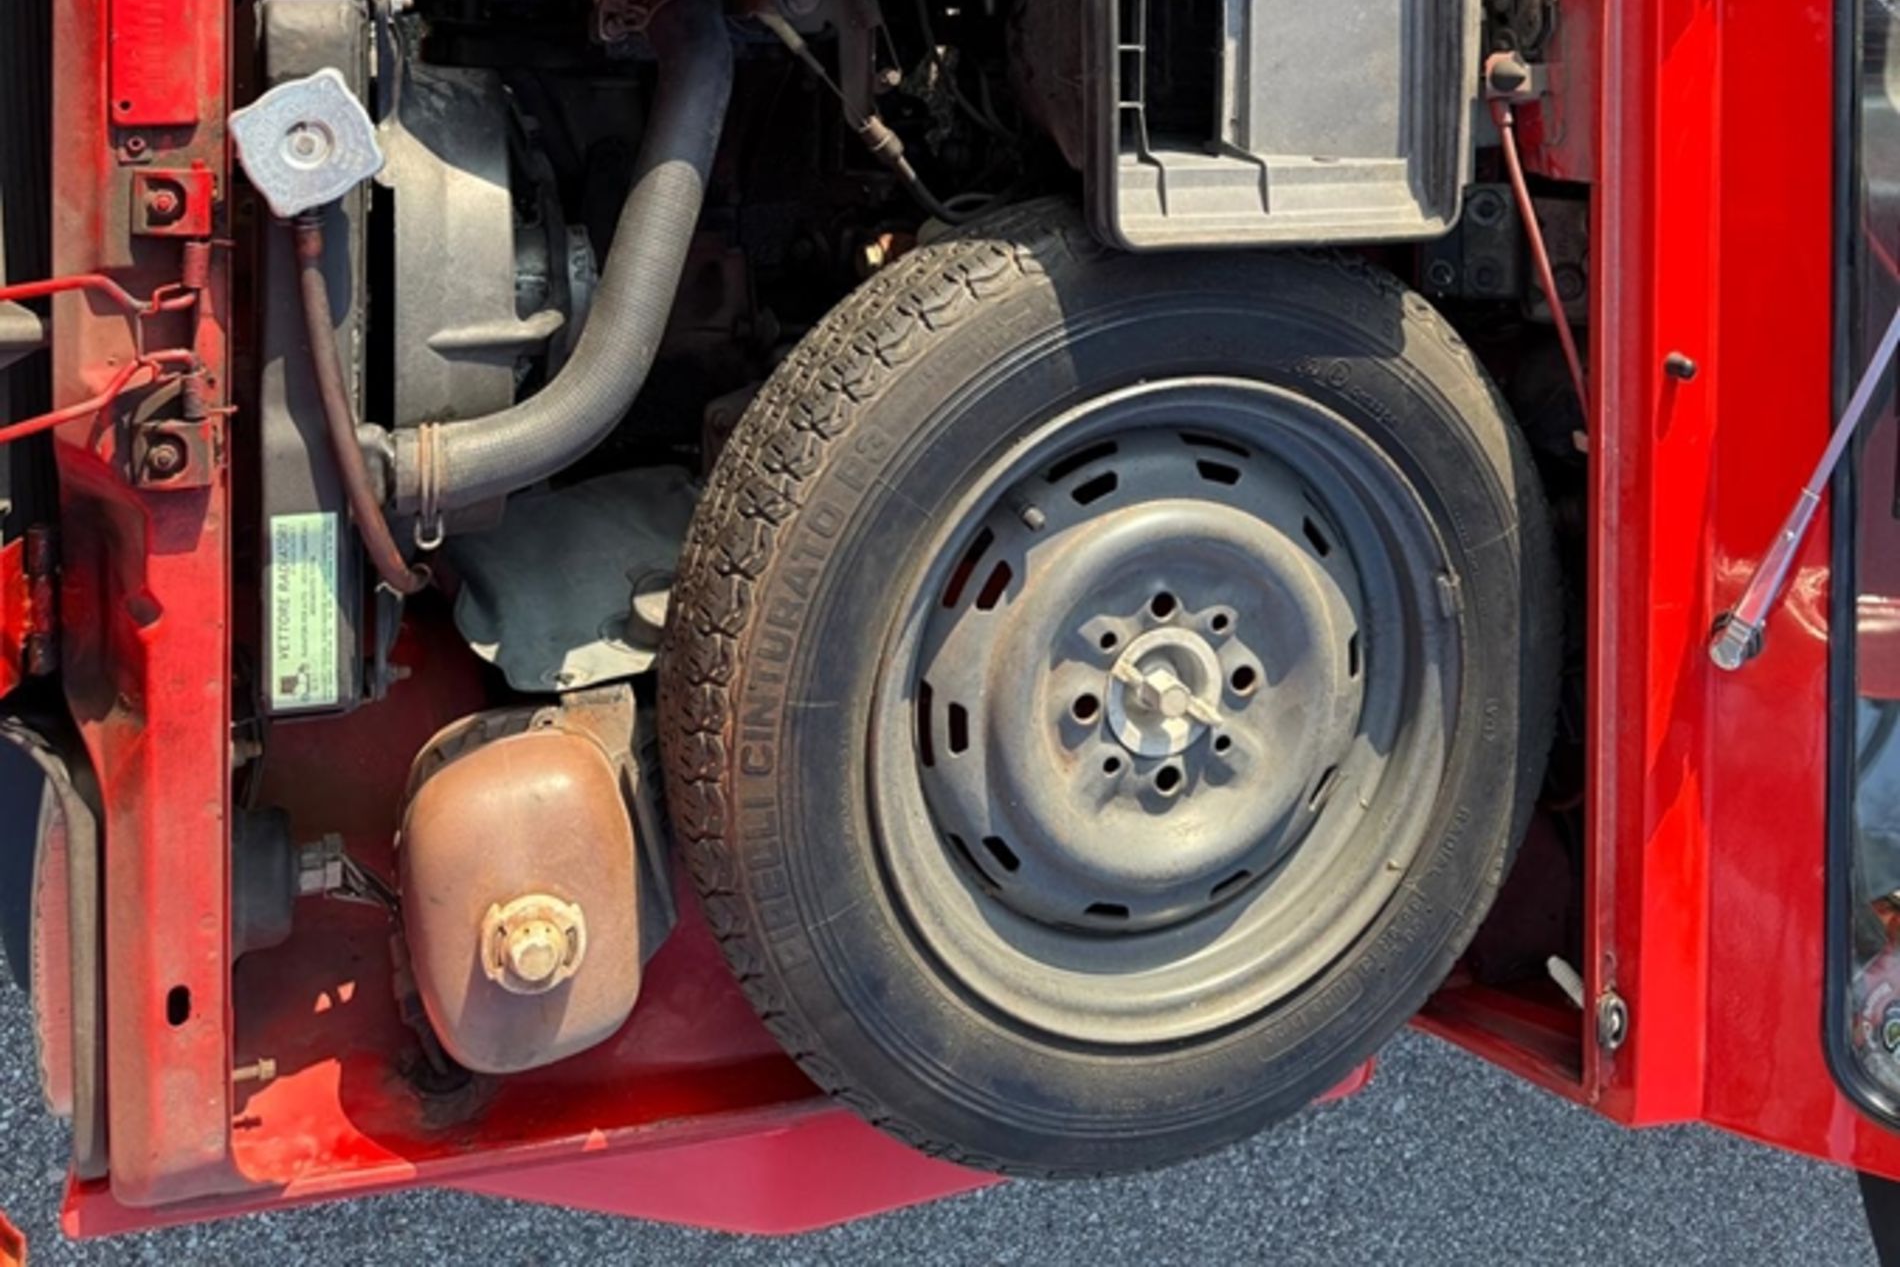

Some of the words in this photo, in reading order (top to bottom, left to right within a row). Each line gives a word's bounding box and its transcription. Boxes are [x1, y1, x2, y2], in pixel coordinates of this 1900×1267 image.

[837, 425, 894, 499] P3
[276, 522, 290, 591] RADIATORI
[277, 596, 291, 660] VETTORE
[741, 501, 843, 778] CINTURATO
[745, 800, 811, 972] PIRELLI
